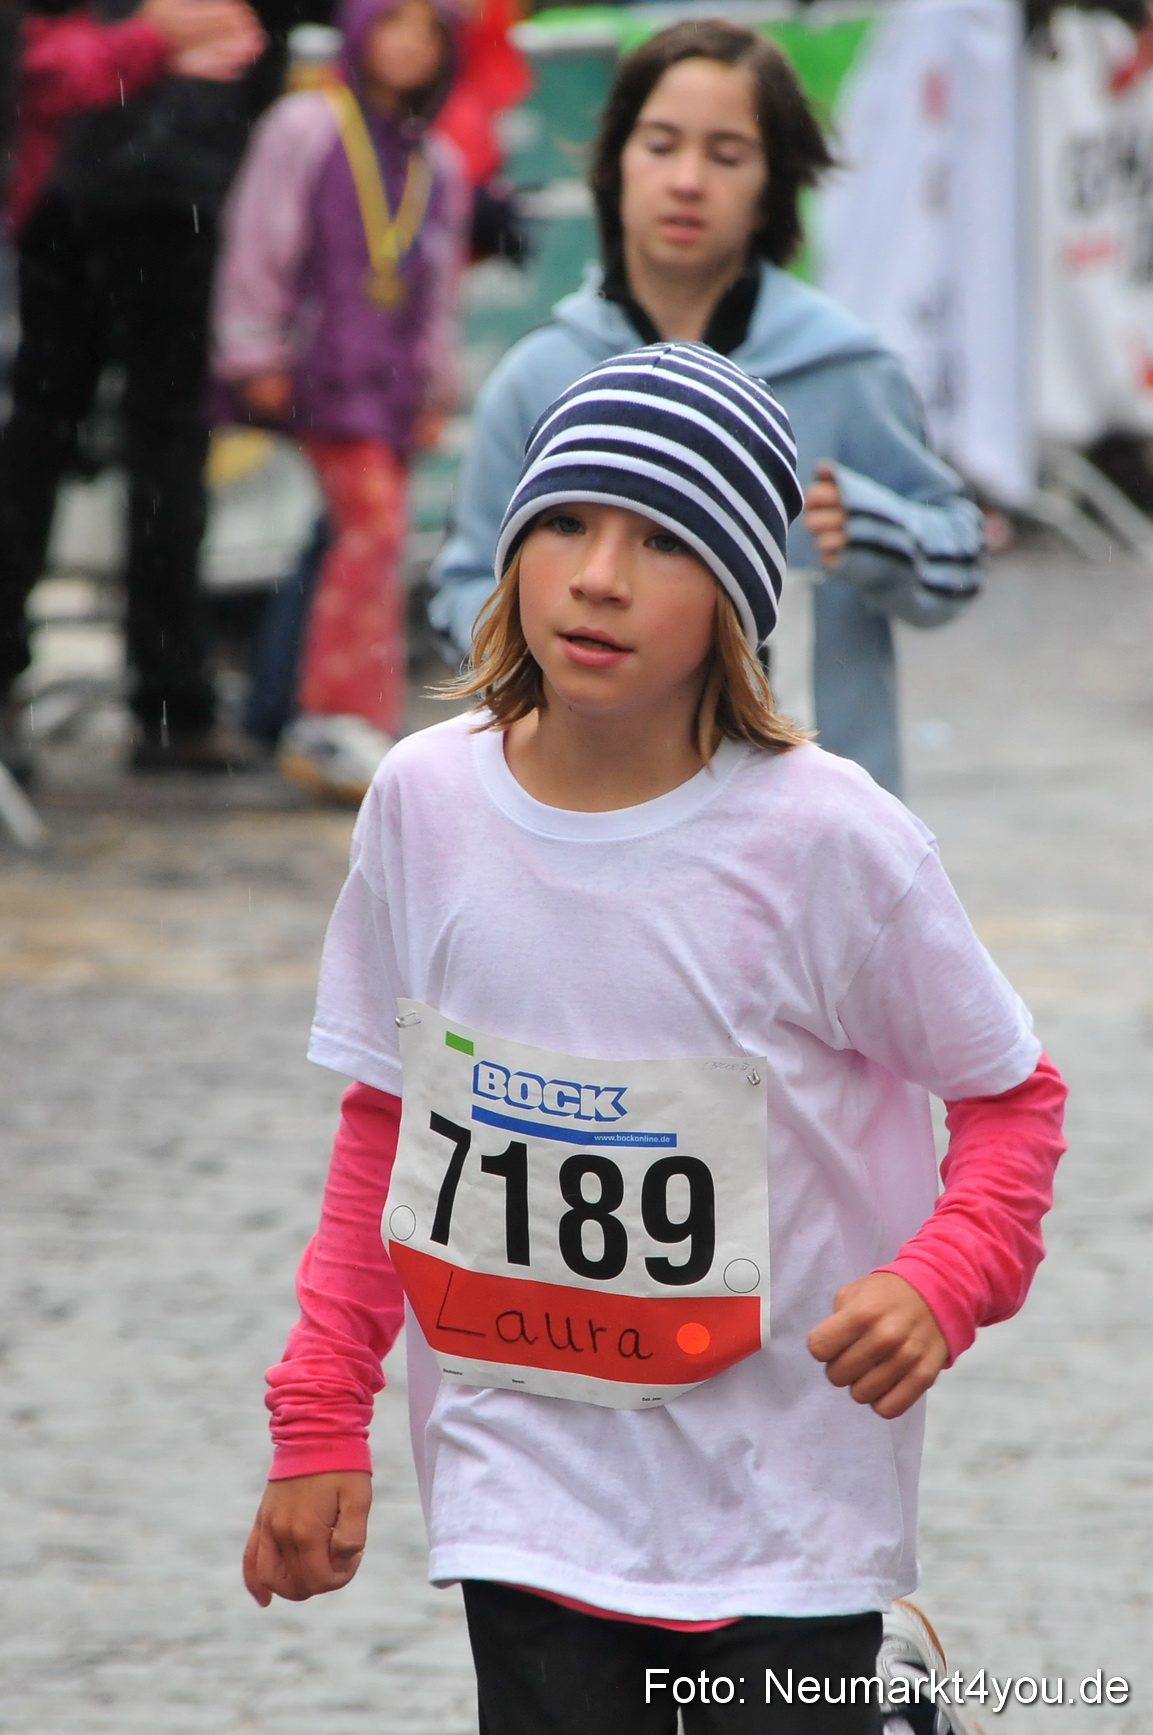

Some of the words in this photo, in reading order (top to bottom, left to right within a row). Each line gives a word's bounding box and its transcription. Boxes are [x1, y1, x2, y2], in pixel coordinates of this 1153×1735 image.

[473, 1060, 628, 1122] BOCK
[593, 1134, 671, 1143] www.bockonline.de
[429, 1110, 716, 1286] 7189
[436, 1271, 653, 1360] Laura
